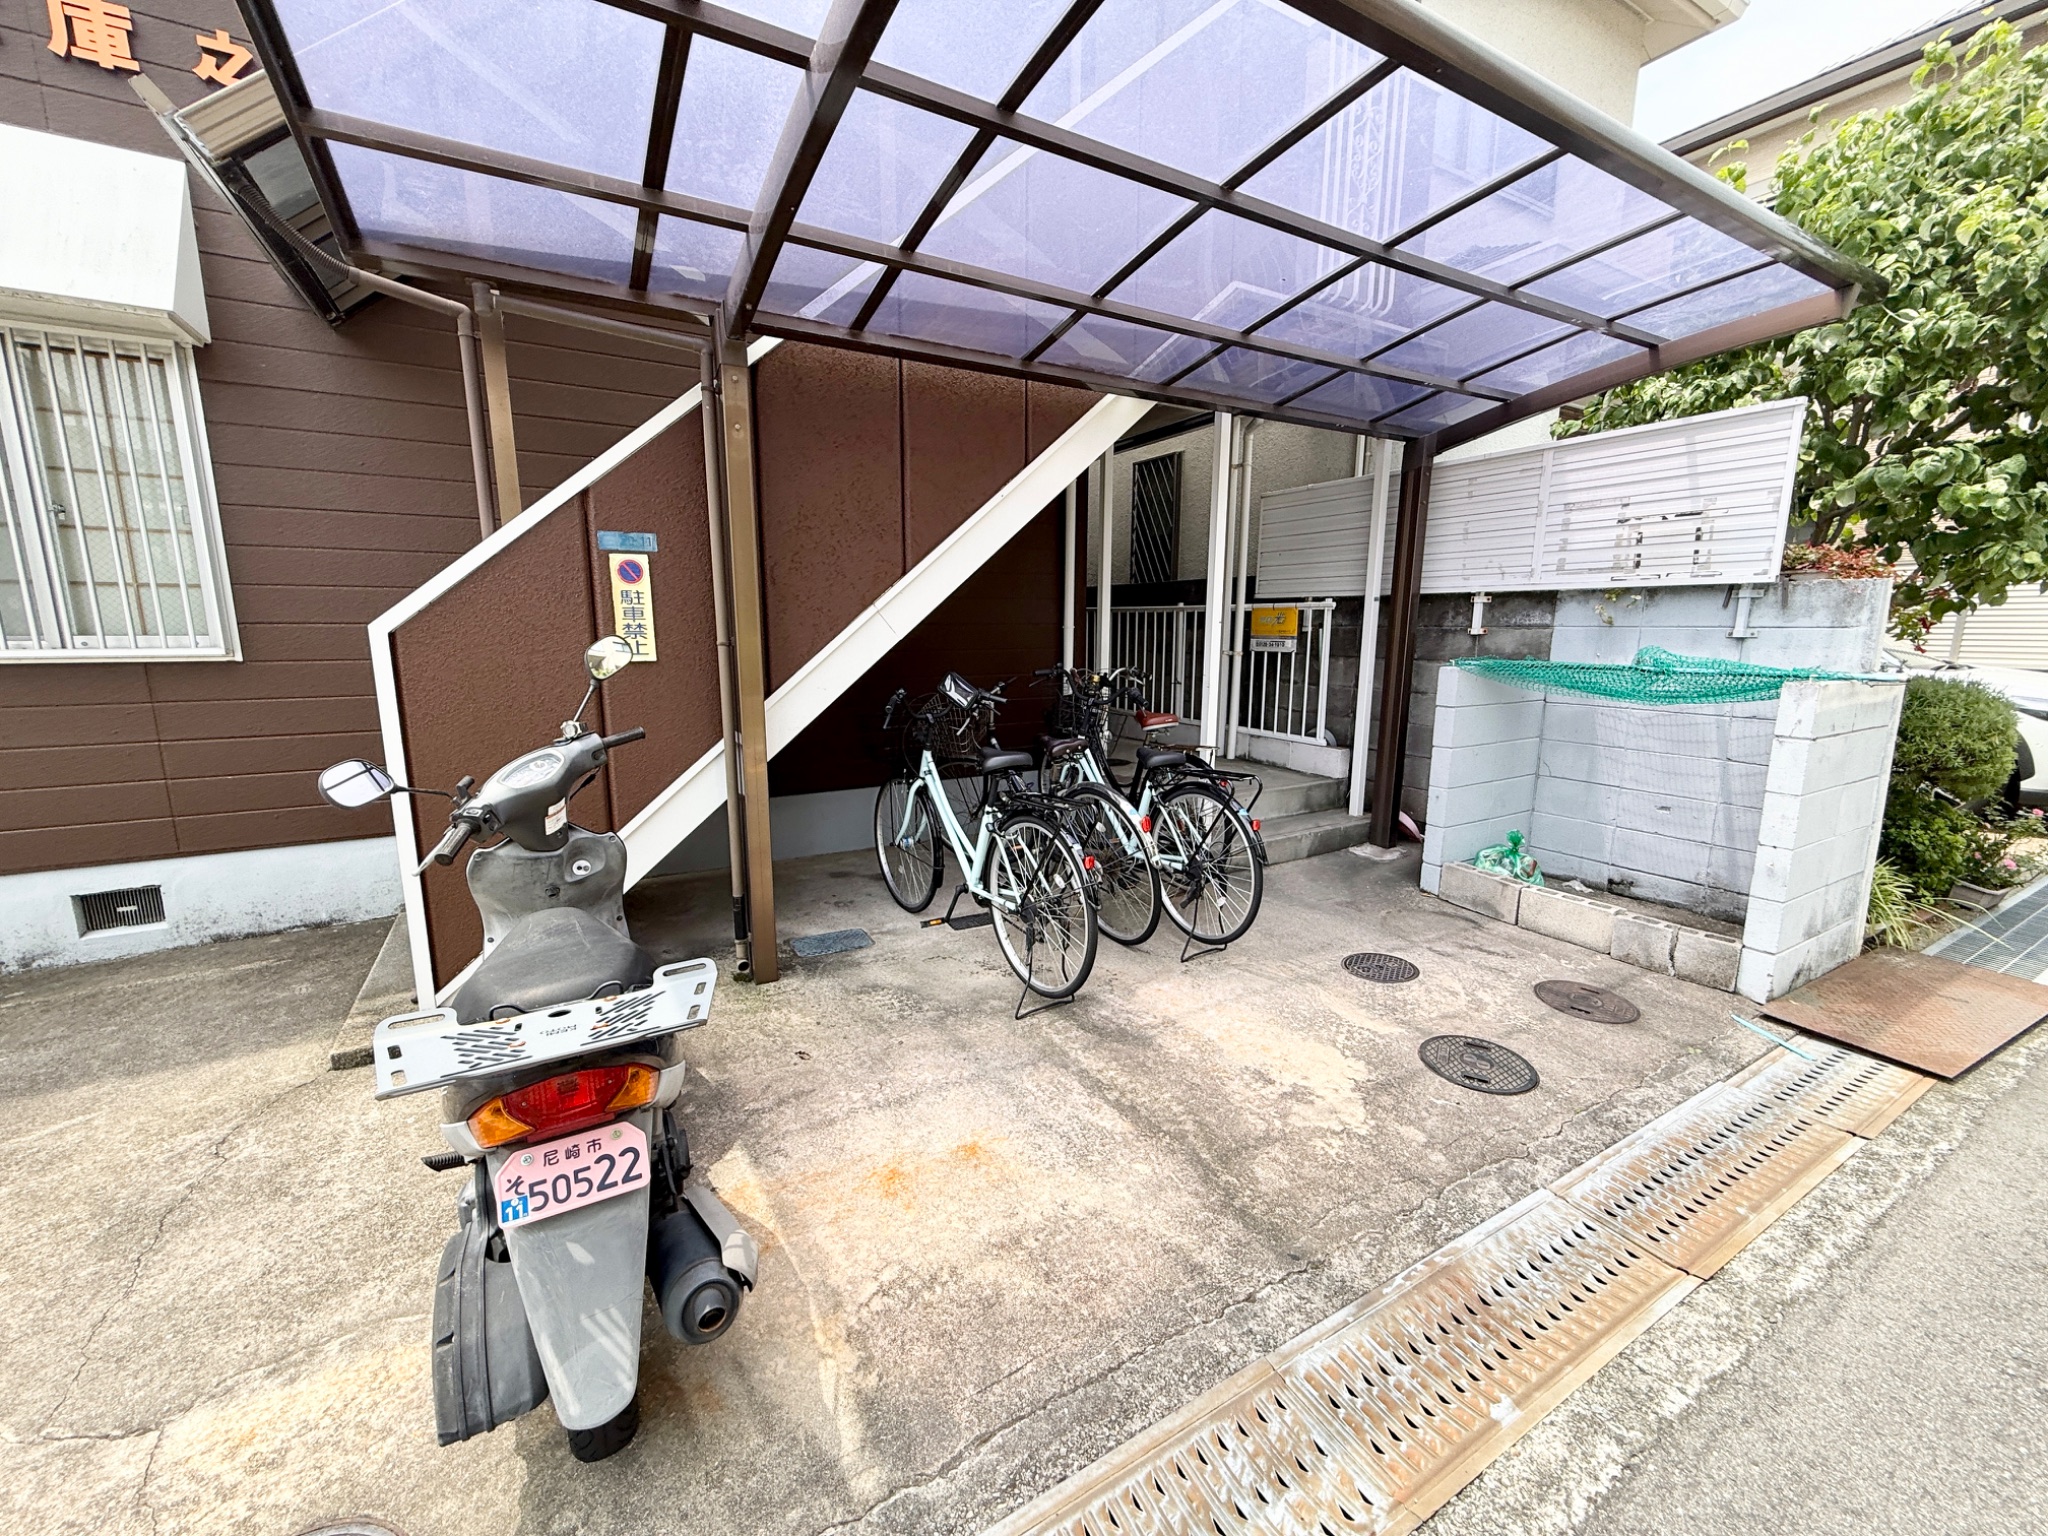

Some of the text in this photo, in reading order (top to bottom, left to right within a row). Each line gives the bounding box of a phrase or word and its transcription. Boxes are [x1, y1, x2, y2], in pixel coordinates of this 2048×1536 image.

[543, 1138, 602, 1167] 尼崎市
[505, 1146, 643, 1212] そ 50522
